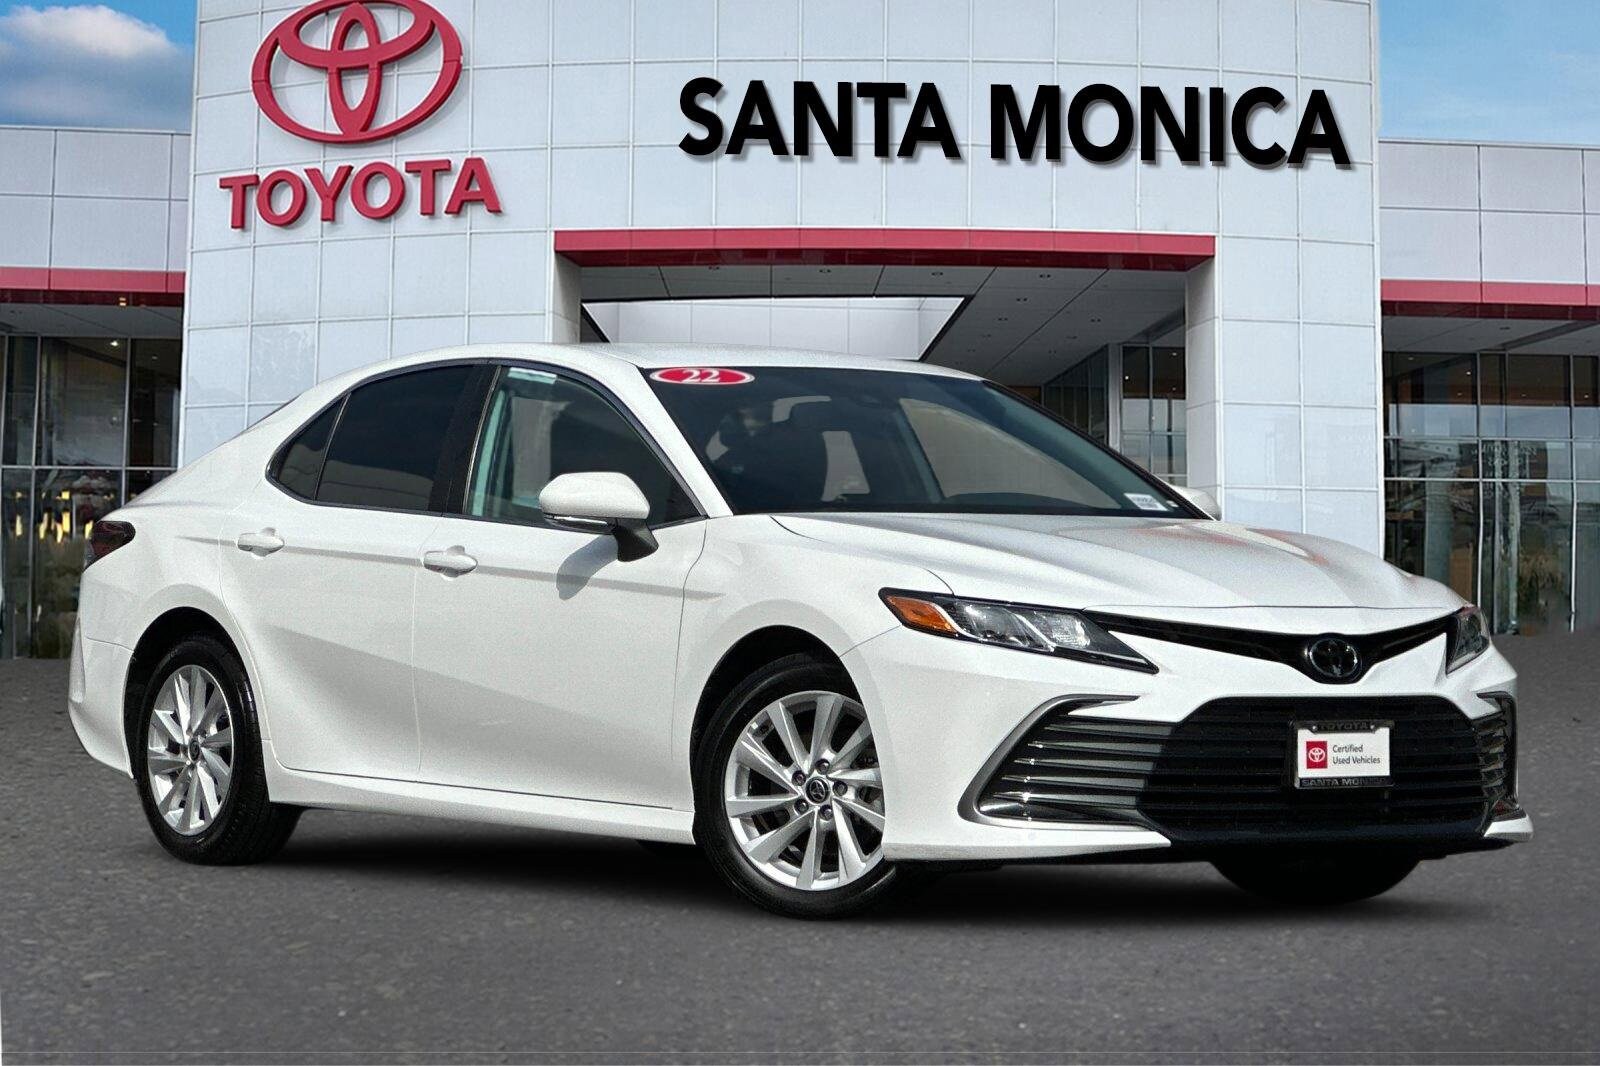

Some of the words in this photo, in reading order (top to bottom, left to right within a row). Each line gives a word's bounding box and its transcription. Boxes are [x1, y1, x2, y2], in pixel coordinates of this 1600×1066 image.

[678, 77, 962, 158] SANTA
[990, 83, 1351, 167] MONICA
[219, 157, 502, 230] TOYOTA
[681, 368, 721, 383] 22
[1332, 744, 1364, 753] Certified
[1332, 756, 1351, 765] Used
[1352, 755, 1381, 765] Vehicles
[1301, 778, 1339, 787] SANTA
